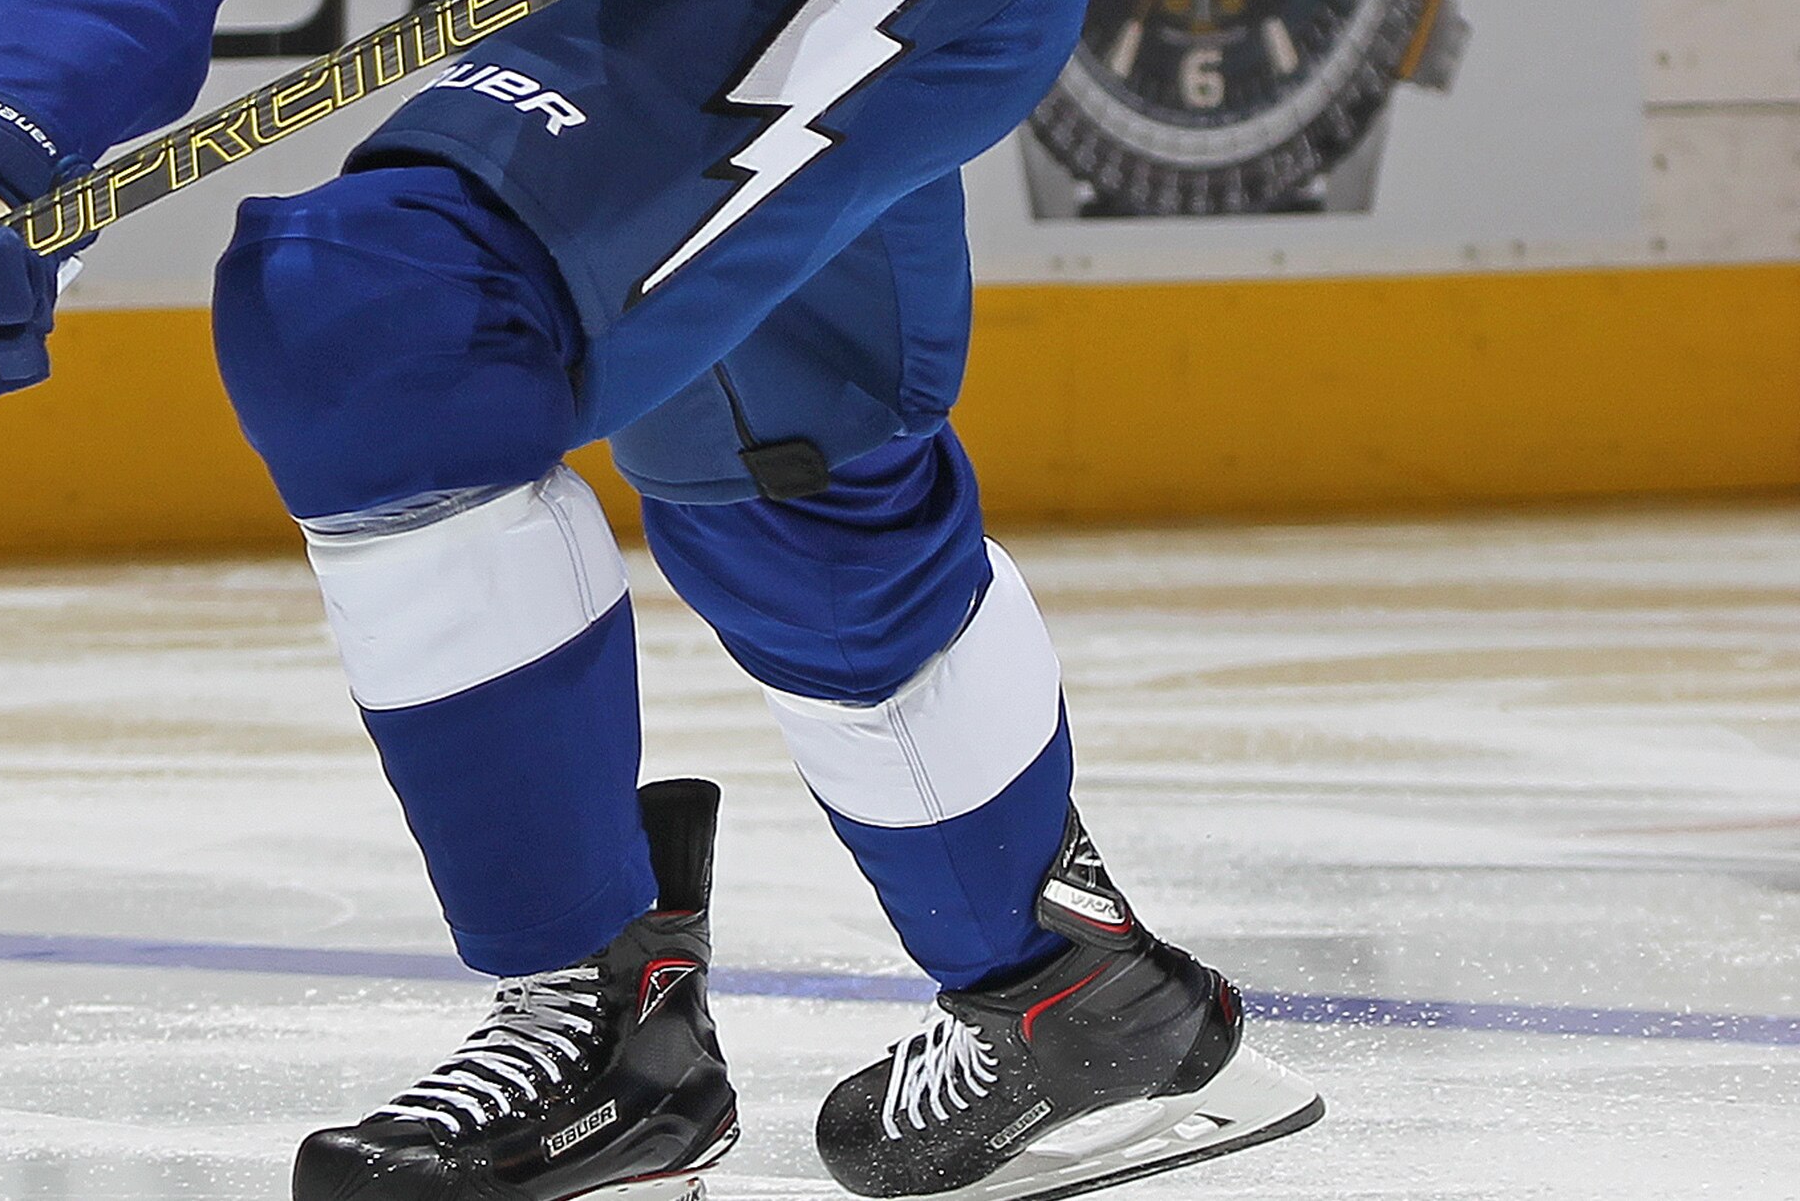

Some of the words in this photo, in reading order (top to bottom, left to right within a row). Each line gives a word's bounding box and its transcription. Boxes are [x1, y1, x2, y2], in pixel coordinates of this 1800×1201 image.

[418, 62, 588, 137] UER
[1180, 51, 1225, 108] 6
[552, 1105, 615, 1152] BAUER
